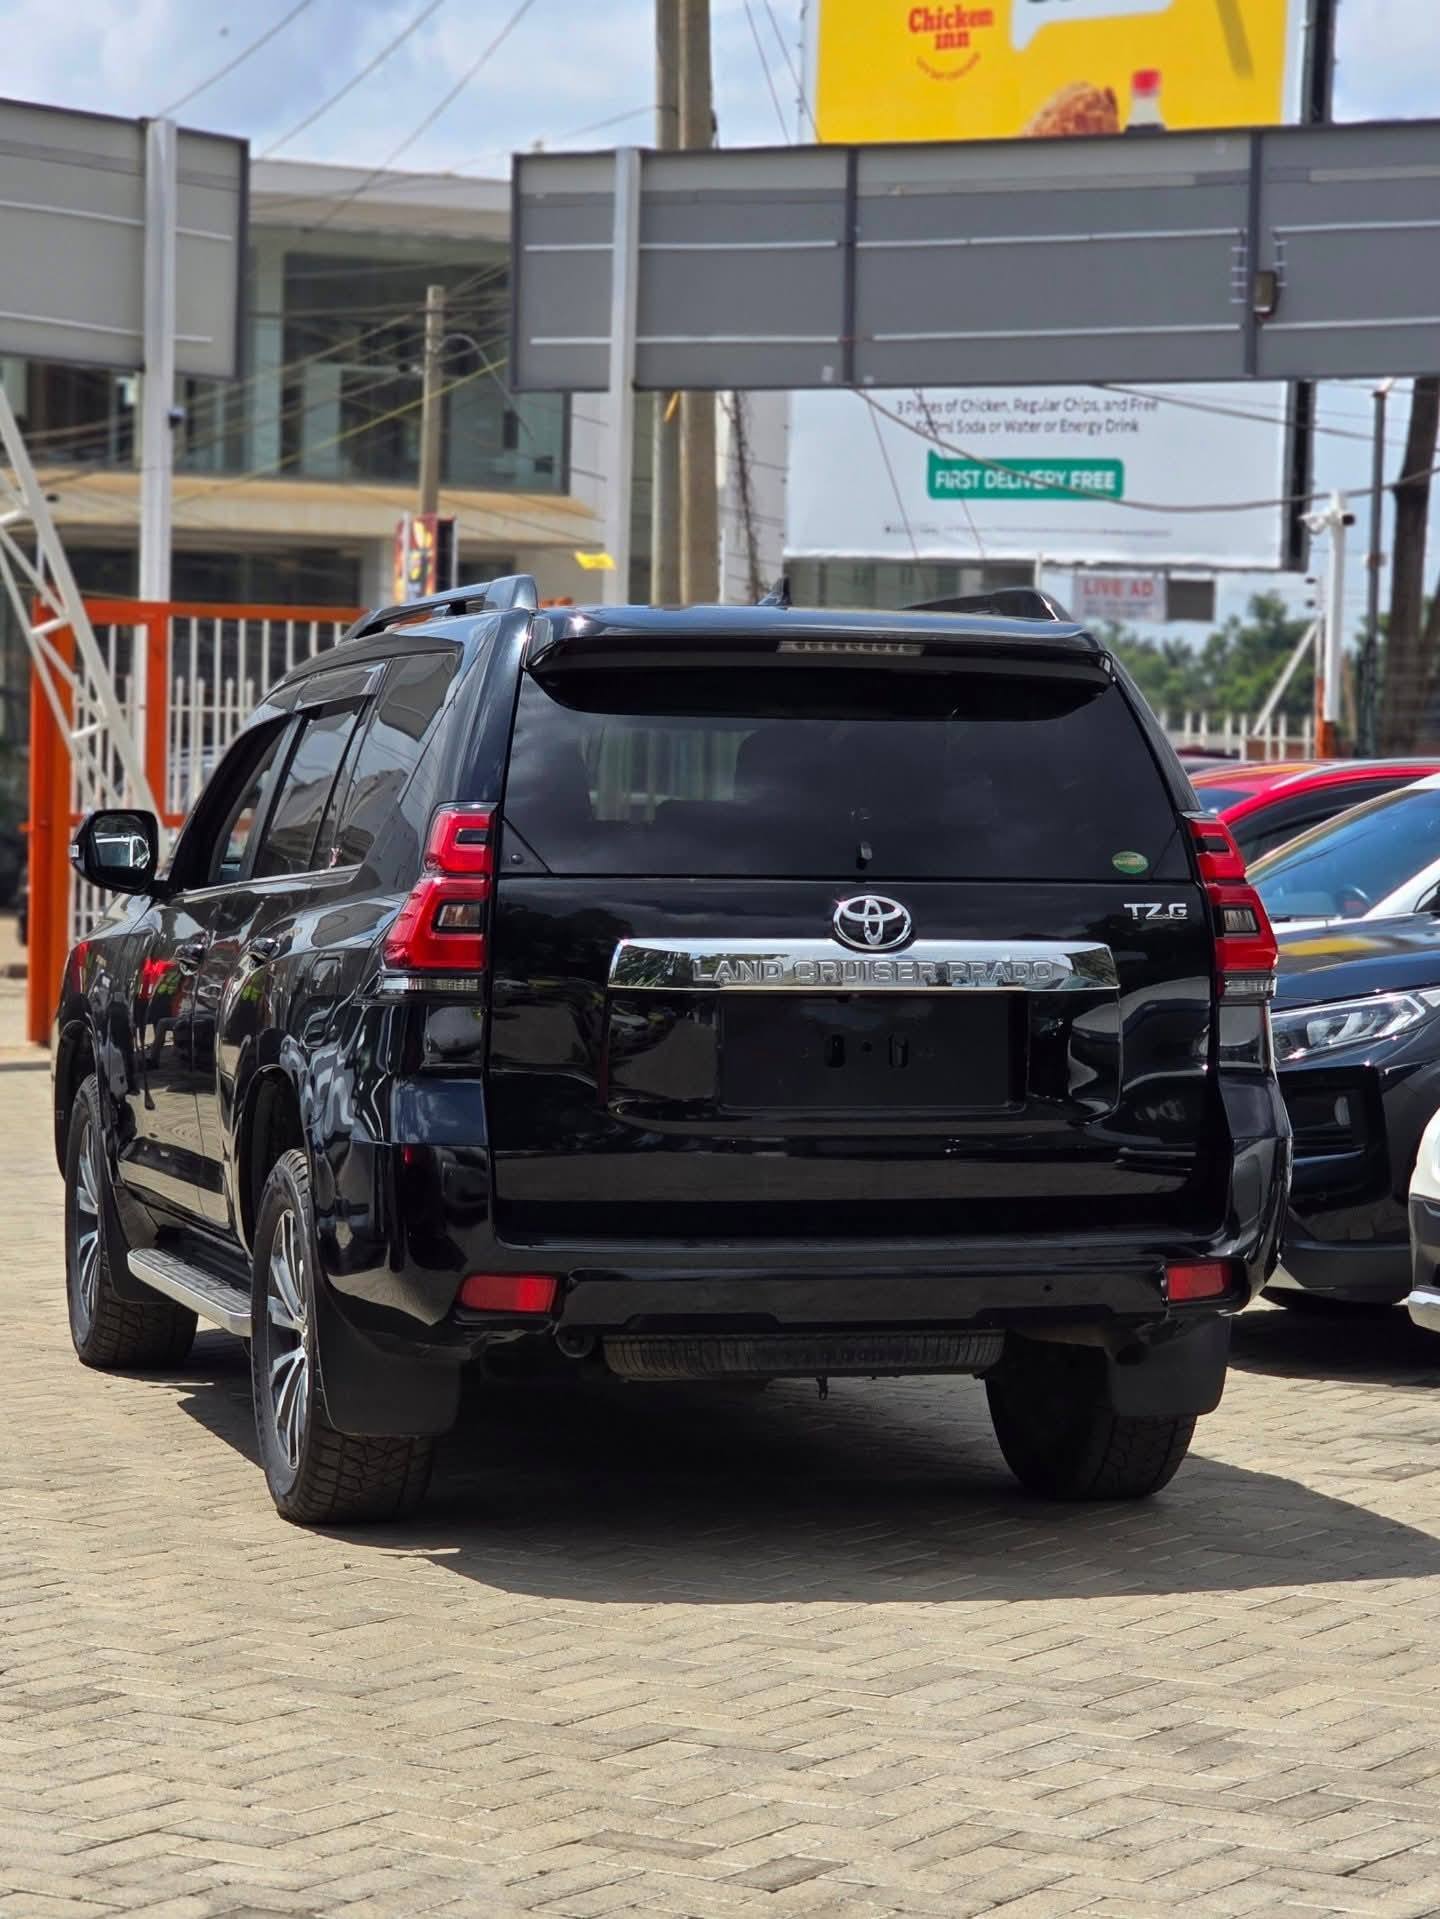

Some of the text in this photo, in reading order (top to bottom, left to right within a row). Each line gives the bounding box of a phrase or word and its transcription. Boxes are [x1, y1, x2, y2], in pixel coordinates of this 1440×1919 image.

[945, 398, 958, 413] of
[1013, 397, 1060, 415] Regular
[1103, 397, 1128, 412] and
[957, 419, 986, 433] Soda
[988, 421, 1001, 433] or
[1004, 420, 1041, 433] Water
[1043, 421, 1058, 433] or
[1060, 418, 1102, 436] Energy
[1104, 418, 1140, 433] Drink
[935, 470, 1117, 490] FIRST DELIVERY FREE
[692, 959, 1054, 984] LAND CRUISER PRADO
